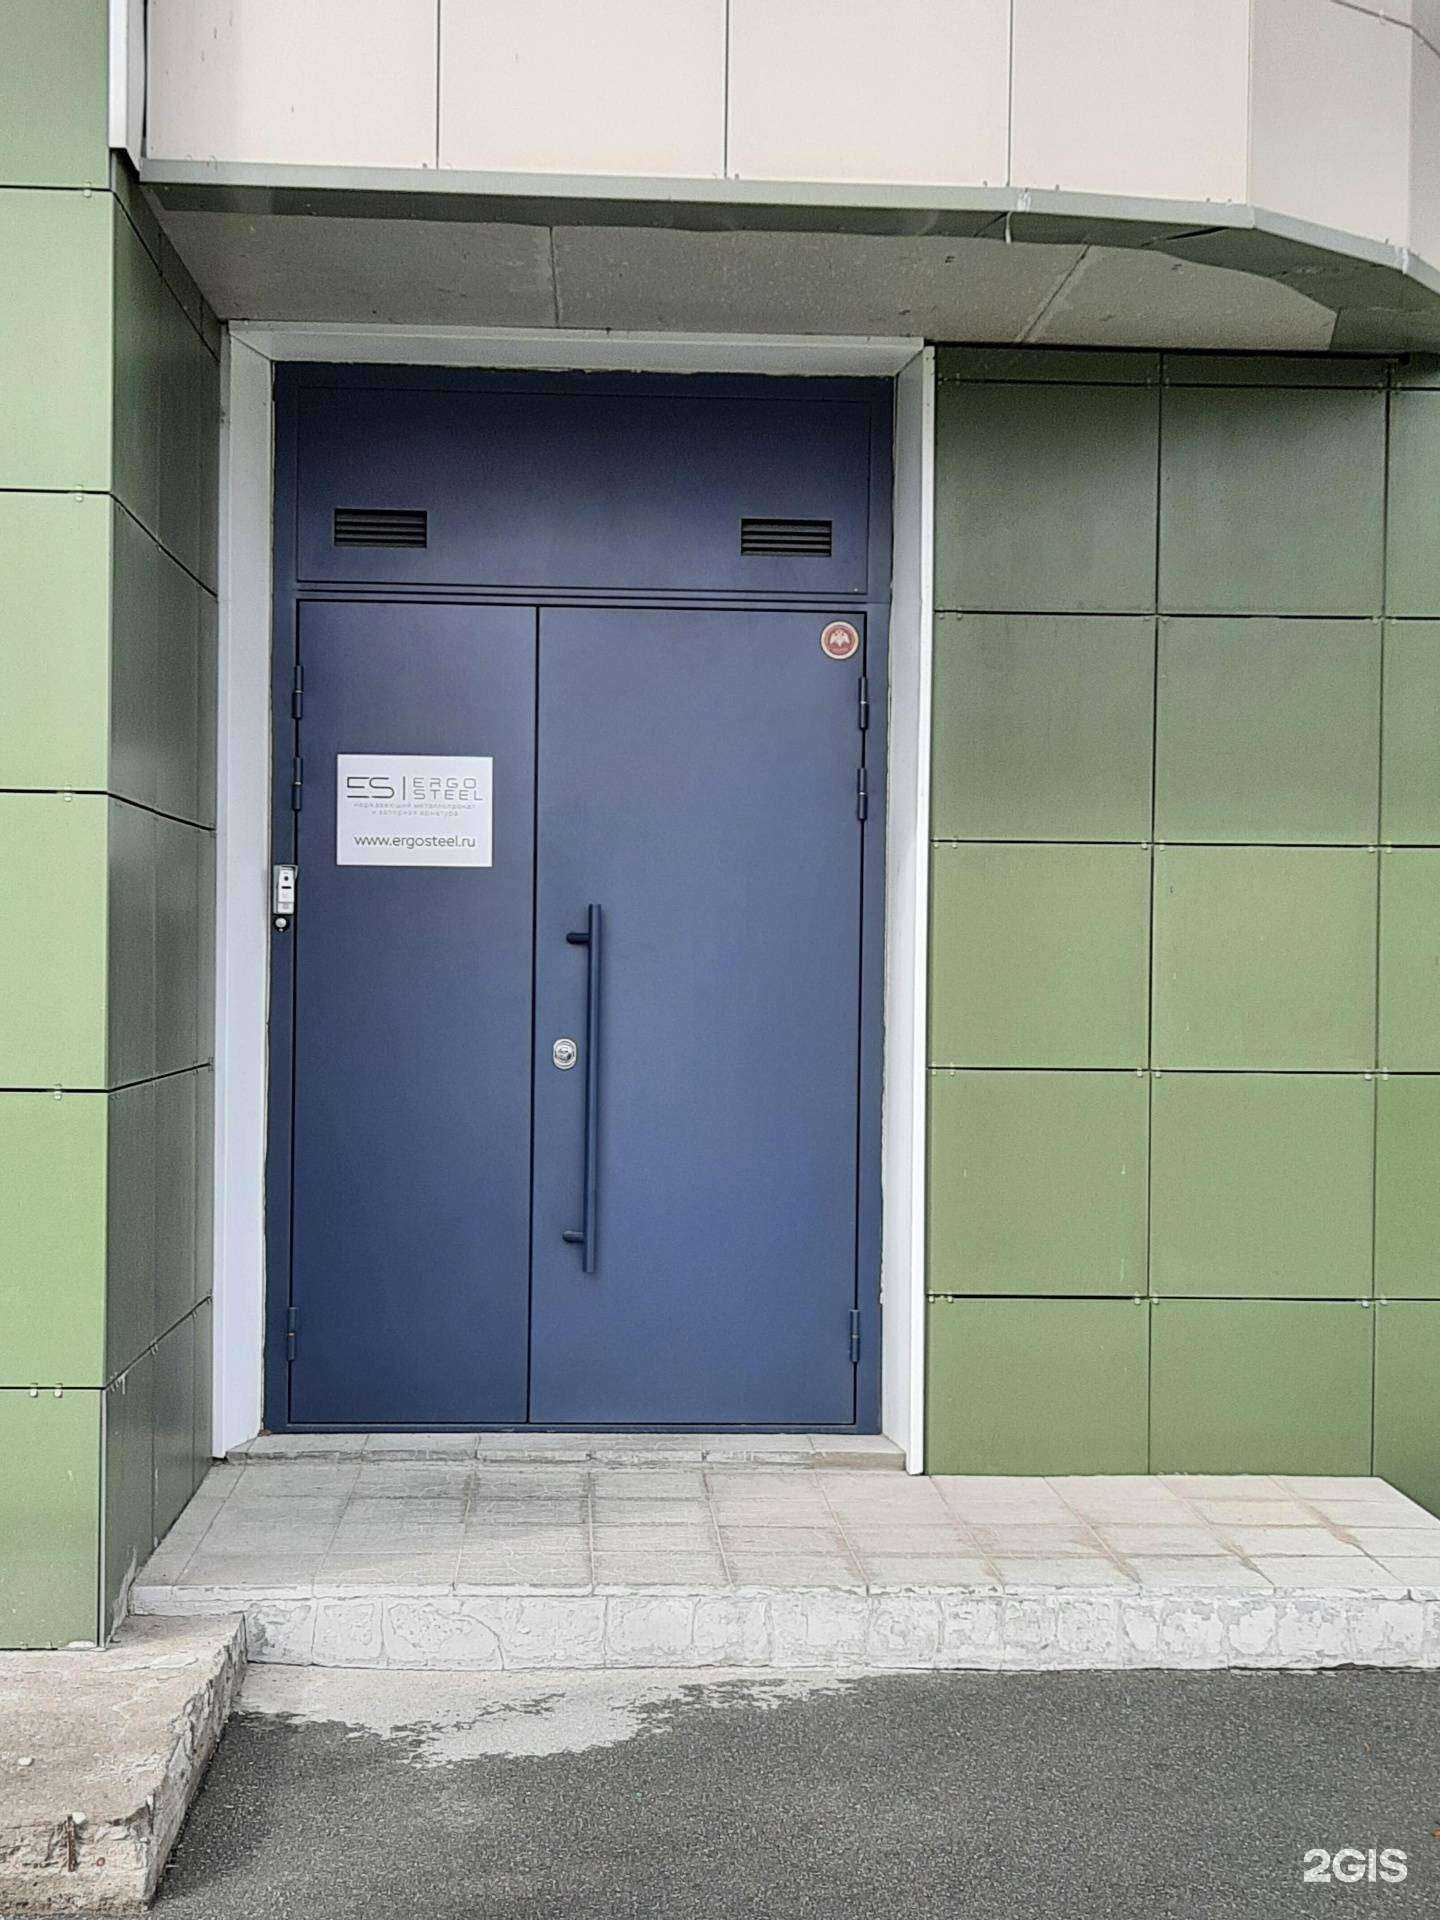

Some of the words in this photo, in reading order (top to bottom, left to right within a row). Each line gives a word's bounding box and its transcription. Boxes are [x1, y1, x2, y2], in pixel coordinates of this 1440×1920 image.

[412, 777, 478, 789] ERGO
[413, 789, 483, 801] STEEL
[353, 835, 476, 850] www.ergosteel.ru
